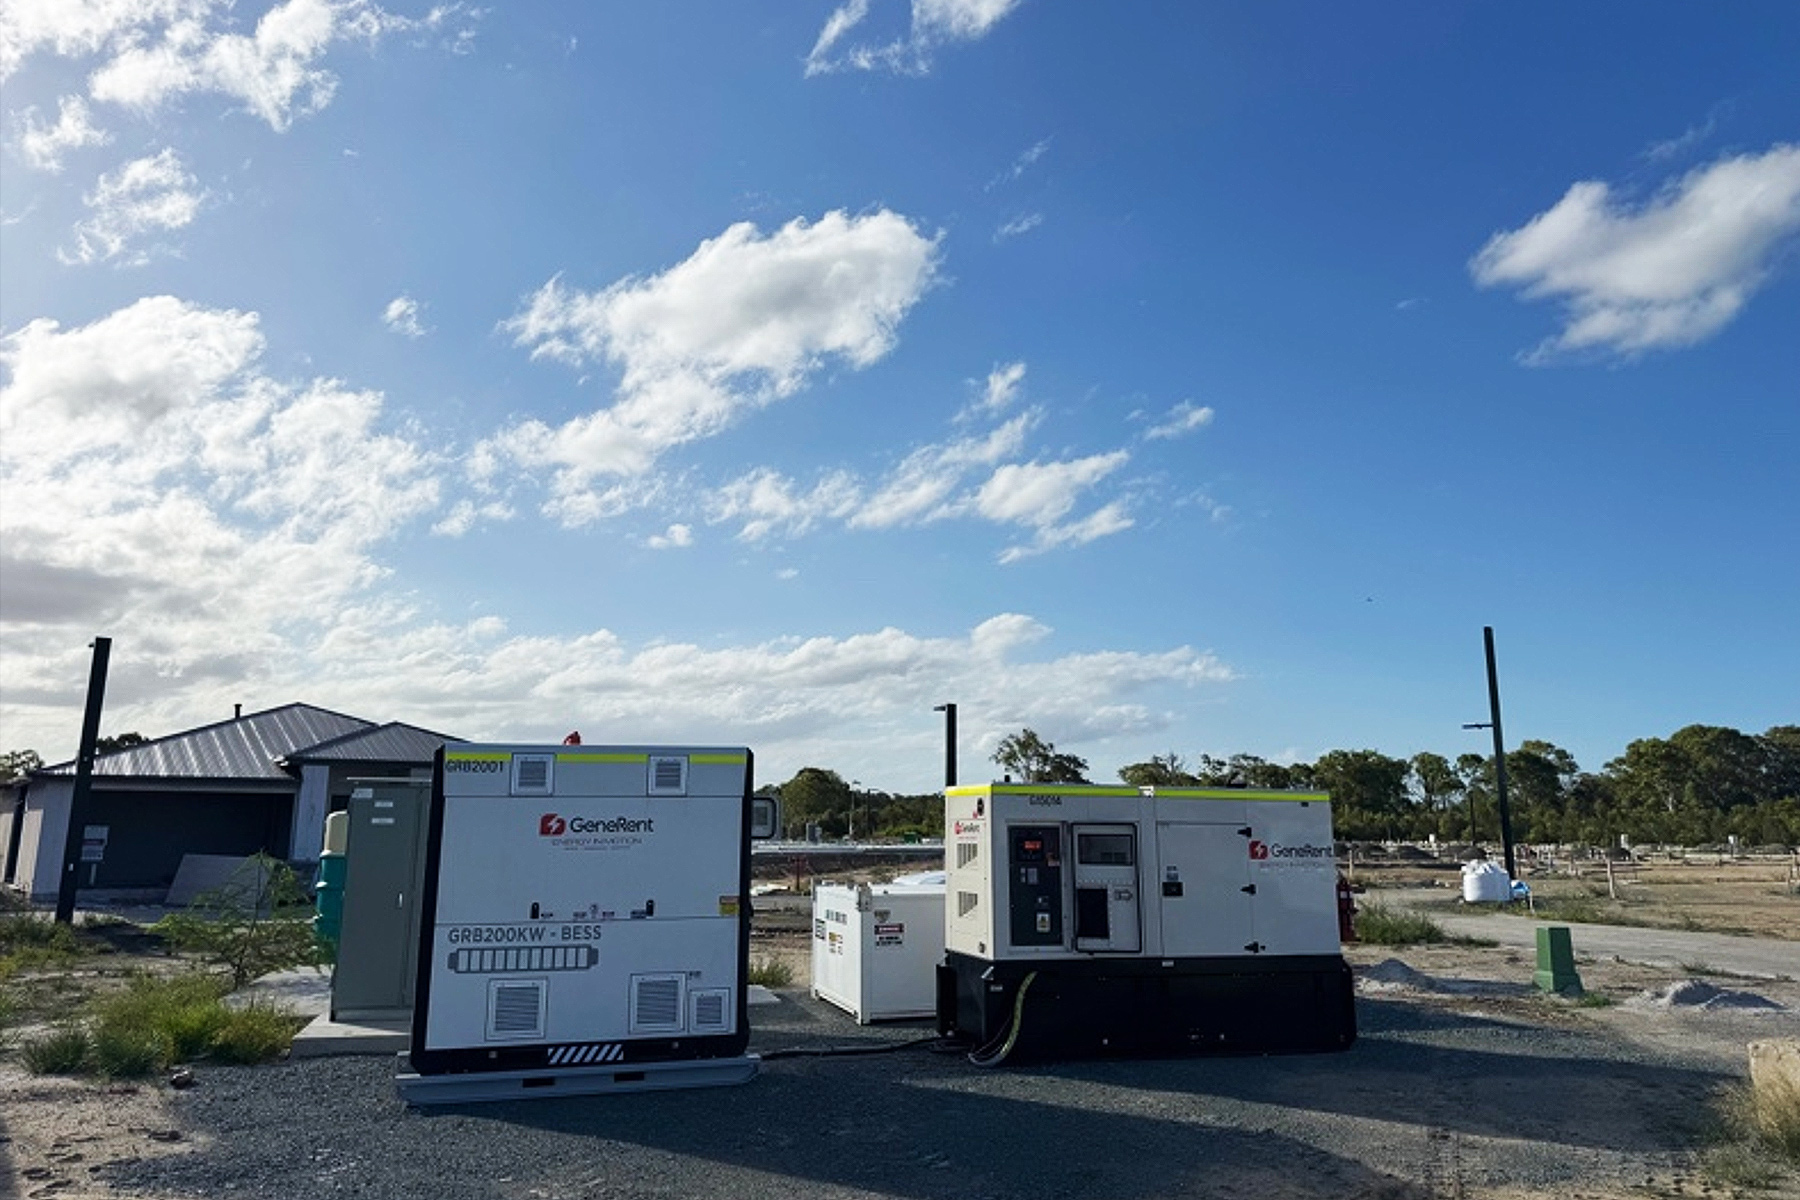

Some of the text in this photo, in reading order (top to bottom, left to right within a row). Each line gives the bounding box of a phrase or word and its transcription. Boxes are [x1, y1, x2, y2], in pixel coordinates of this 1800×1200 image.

[445, 760, 504, 773] GRB2001
[570, 817, 654, 833] GeneRent
[1271, 843, 1333, 858] GeneRent
[449, 926, 546, 943] GRB200KW
[561, 925, 602, 940] BESS
